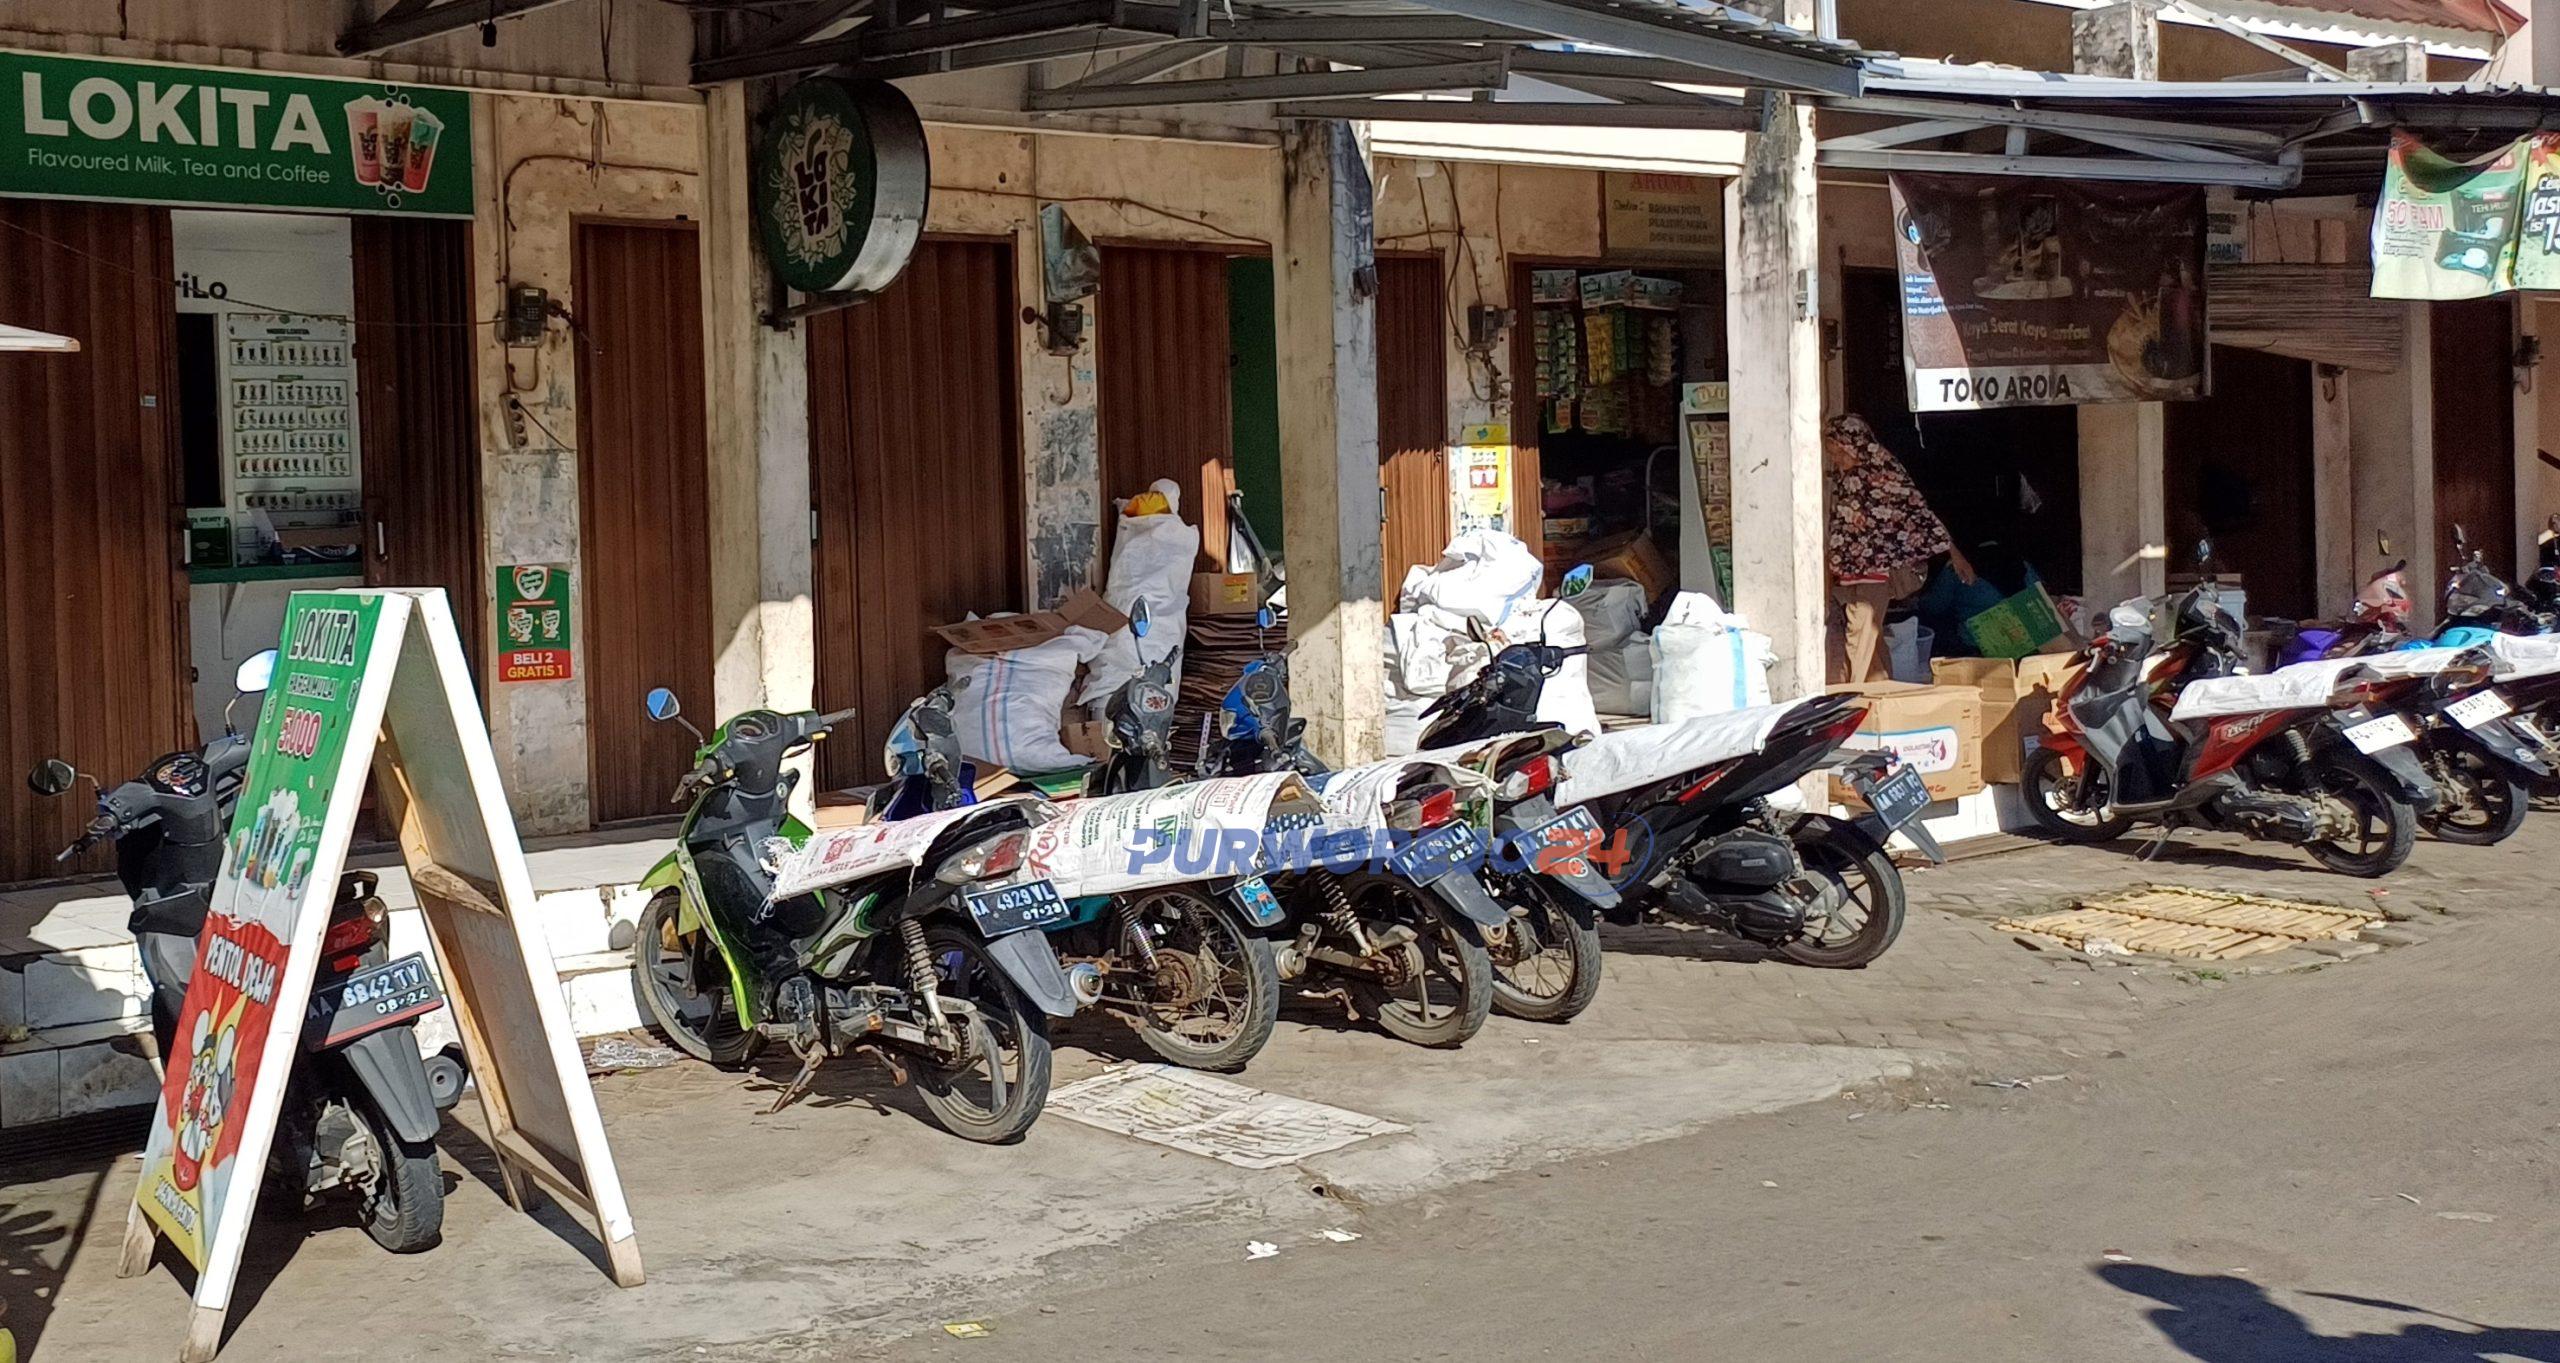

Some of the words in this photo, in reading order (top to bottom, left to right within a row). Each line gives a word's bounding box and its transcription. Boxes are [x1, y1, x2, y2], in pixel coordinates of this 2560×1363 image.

[22, 71, 332, 154] LOKITA
[28, 148, 130, 172] Flavoured
[135, 155, 177, 175] Milk,
[182, 158, 218, 178] Tea
[223, 161, 262, 180] and
[267, 163, 331, 185] Coffee
[1939, 376, 2000, 402] TOKO
[288, 607, 359, 667] LOKITA
[507, 665, 555, 679] GRATIS
[557, 664, 563, 676] 1
[513, 653, 543, 666] BELI
[545, 652, 554, 663] 2
[969, 898, 991, 916] AA
[997, 889, 1032, 910] 4929
[1029, 883, 1056, 902] VL
[203, 933, 245, 989] PENTOL
[241, 951, 276, 1006] DEWA
